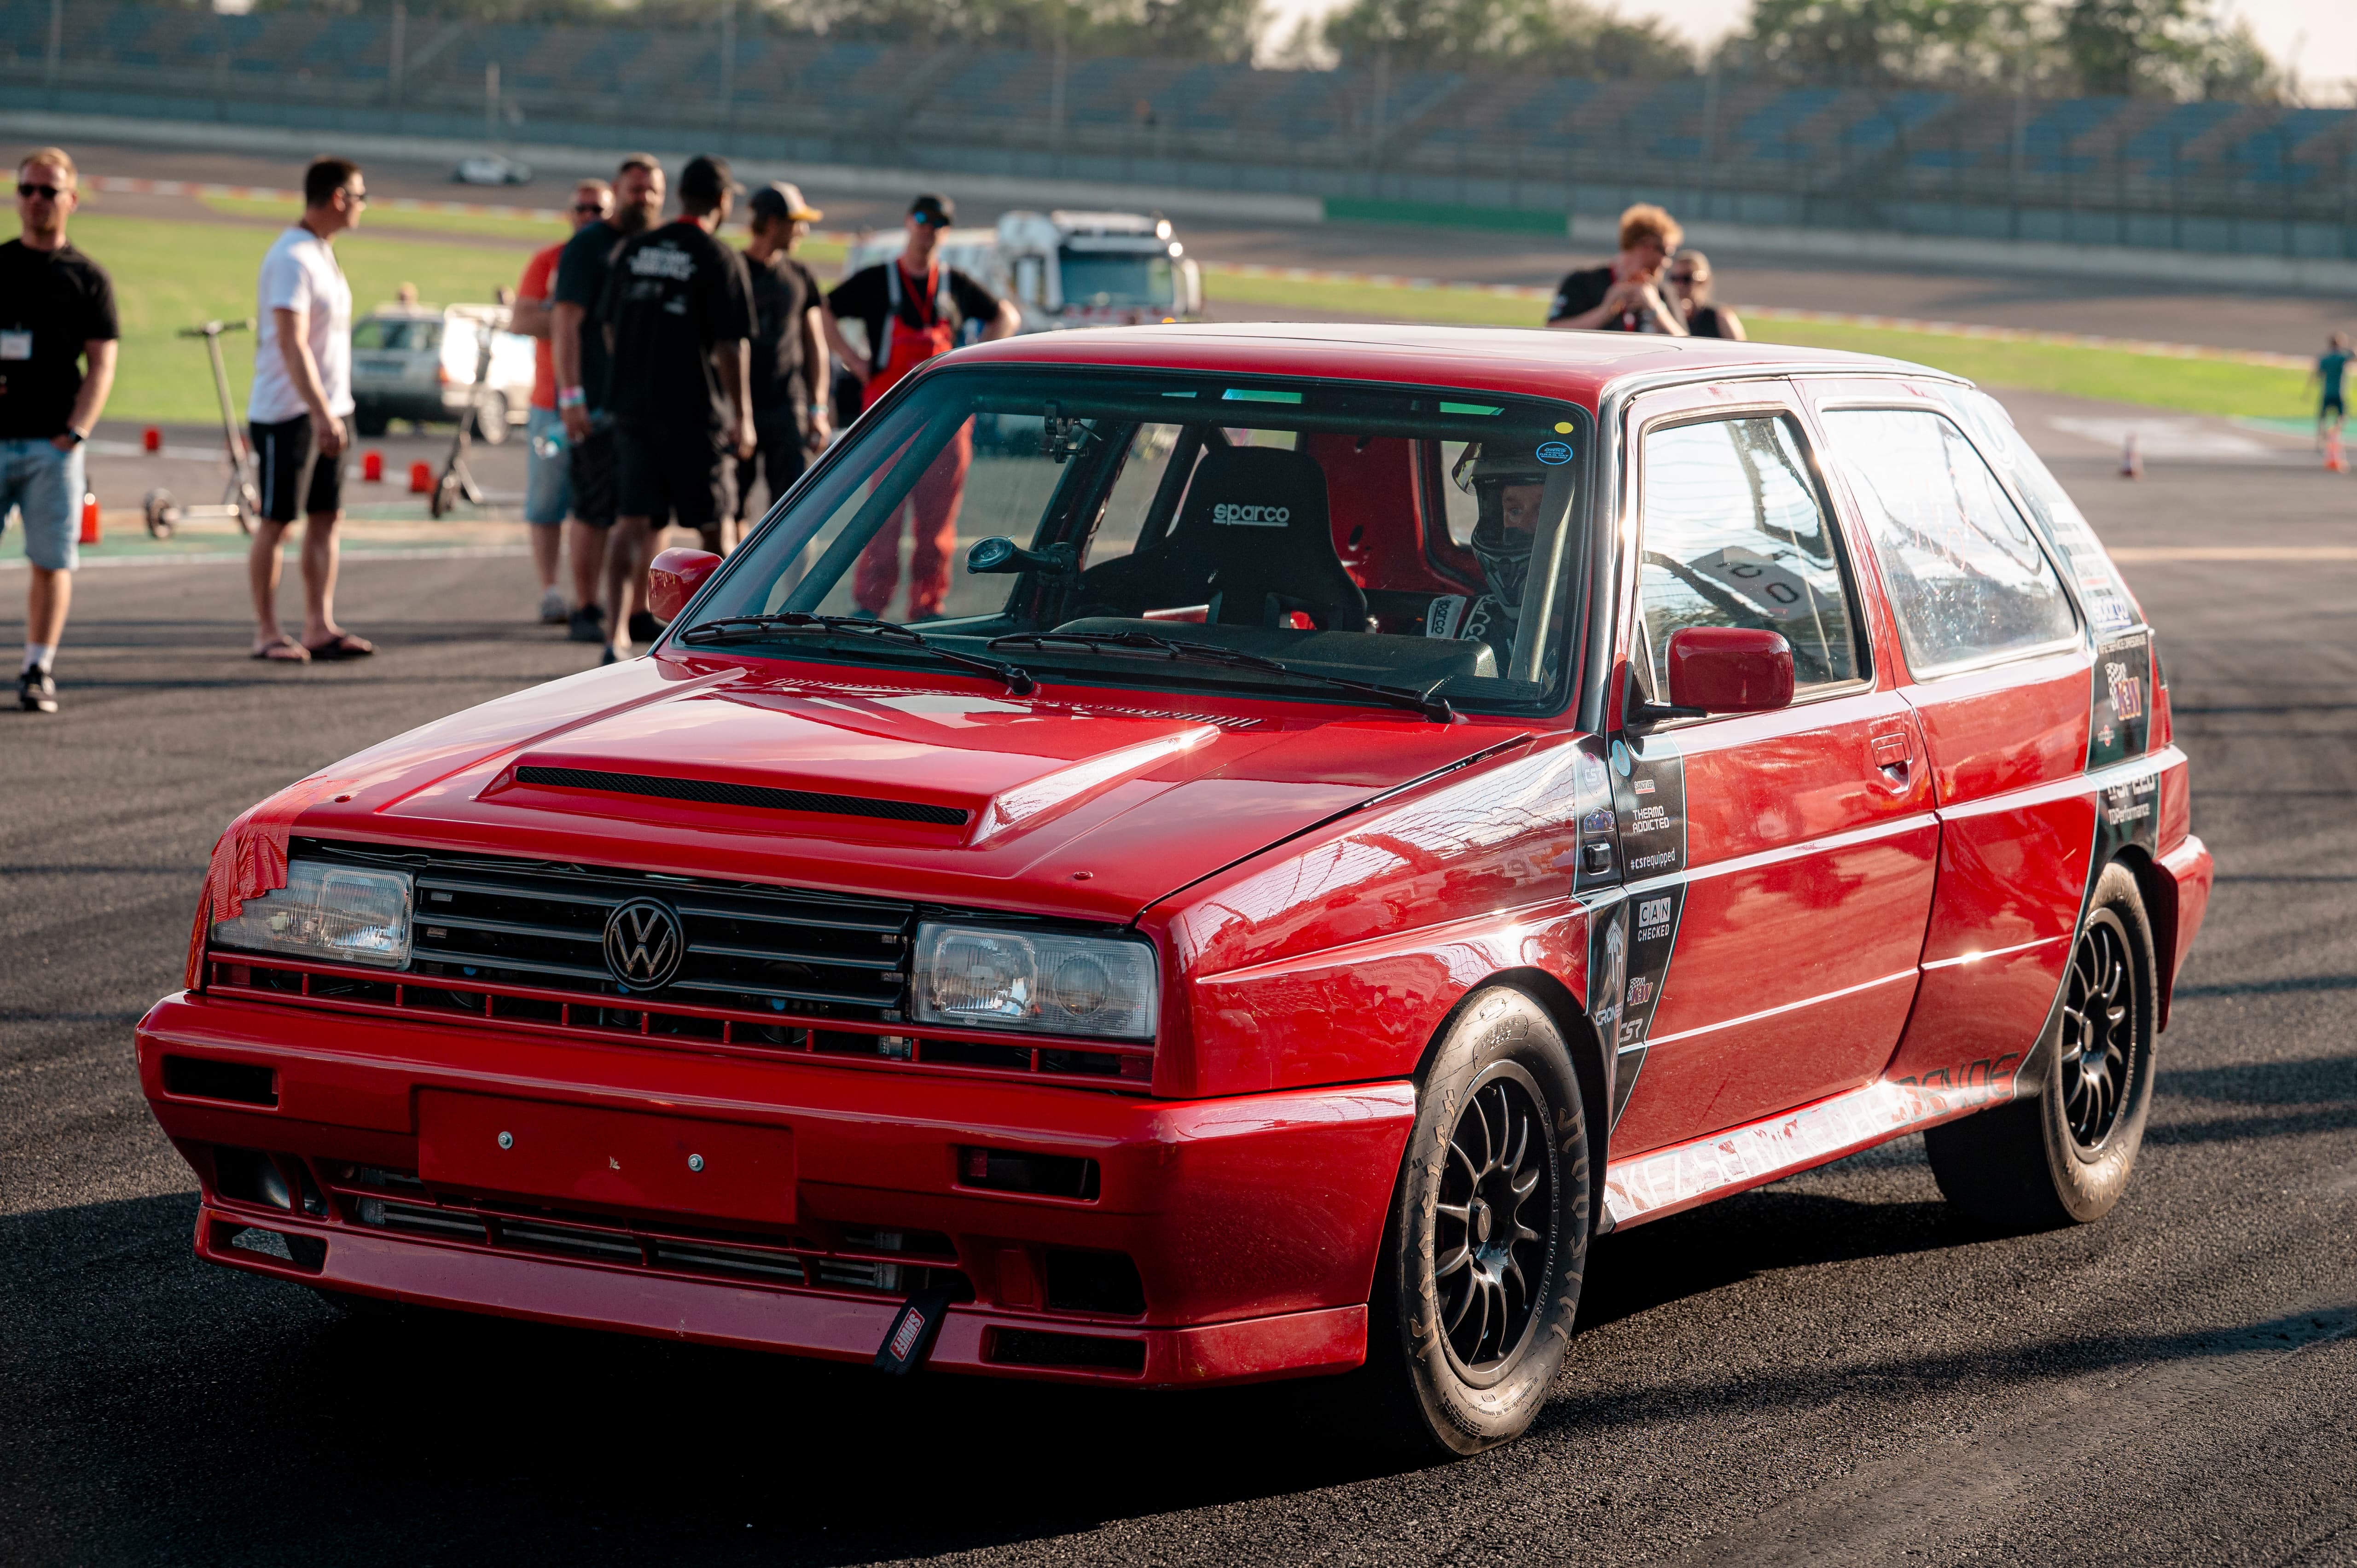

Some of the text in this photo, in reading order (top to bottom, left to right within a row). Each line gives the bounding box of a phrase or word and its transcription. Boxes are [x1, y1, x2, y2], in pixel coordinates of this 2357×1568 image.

[1213, 503, 1290, 527] sparco
[1432, 599, 1451, 635] sparco
[1632, 805, 1664, 820] THERMO
[1632, 817, 1670, 833] ADDICTED
[1630, 847, 1676, 870] #csrequipped
[1641, 900, 1670, 923] CAN
[610, 905, 676, 982] VW
[1638, 923, 1669, 942] CHECKED
[1535, 1224, 1558, 1323] MOTORSPORT
